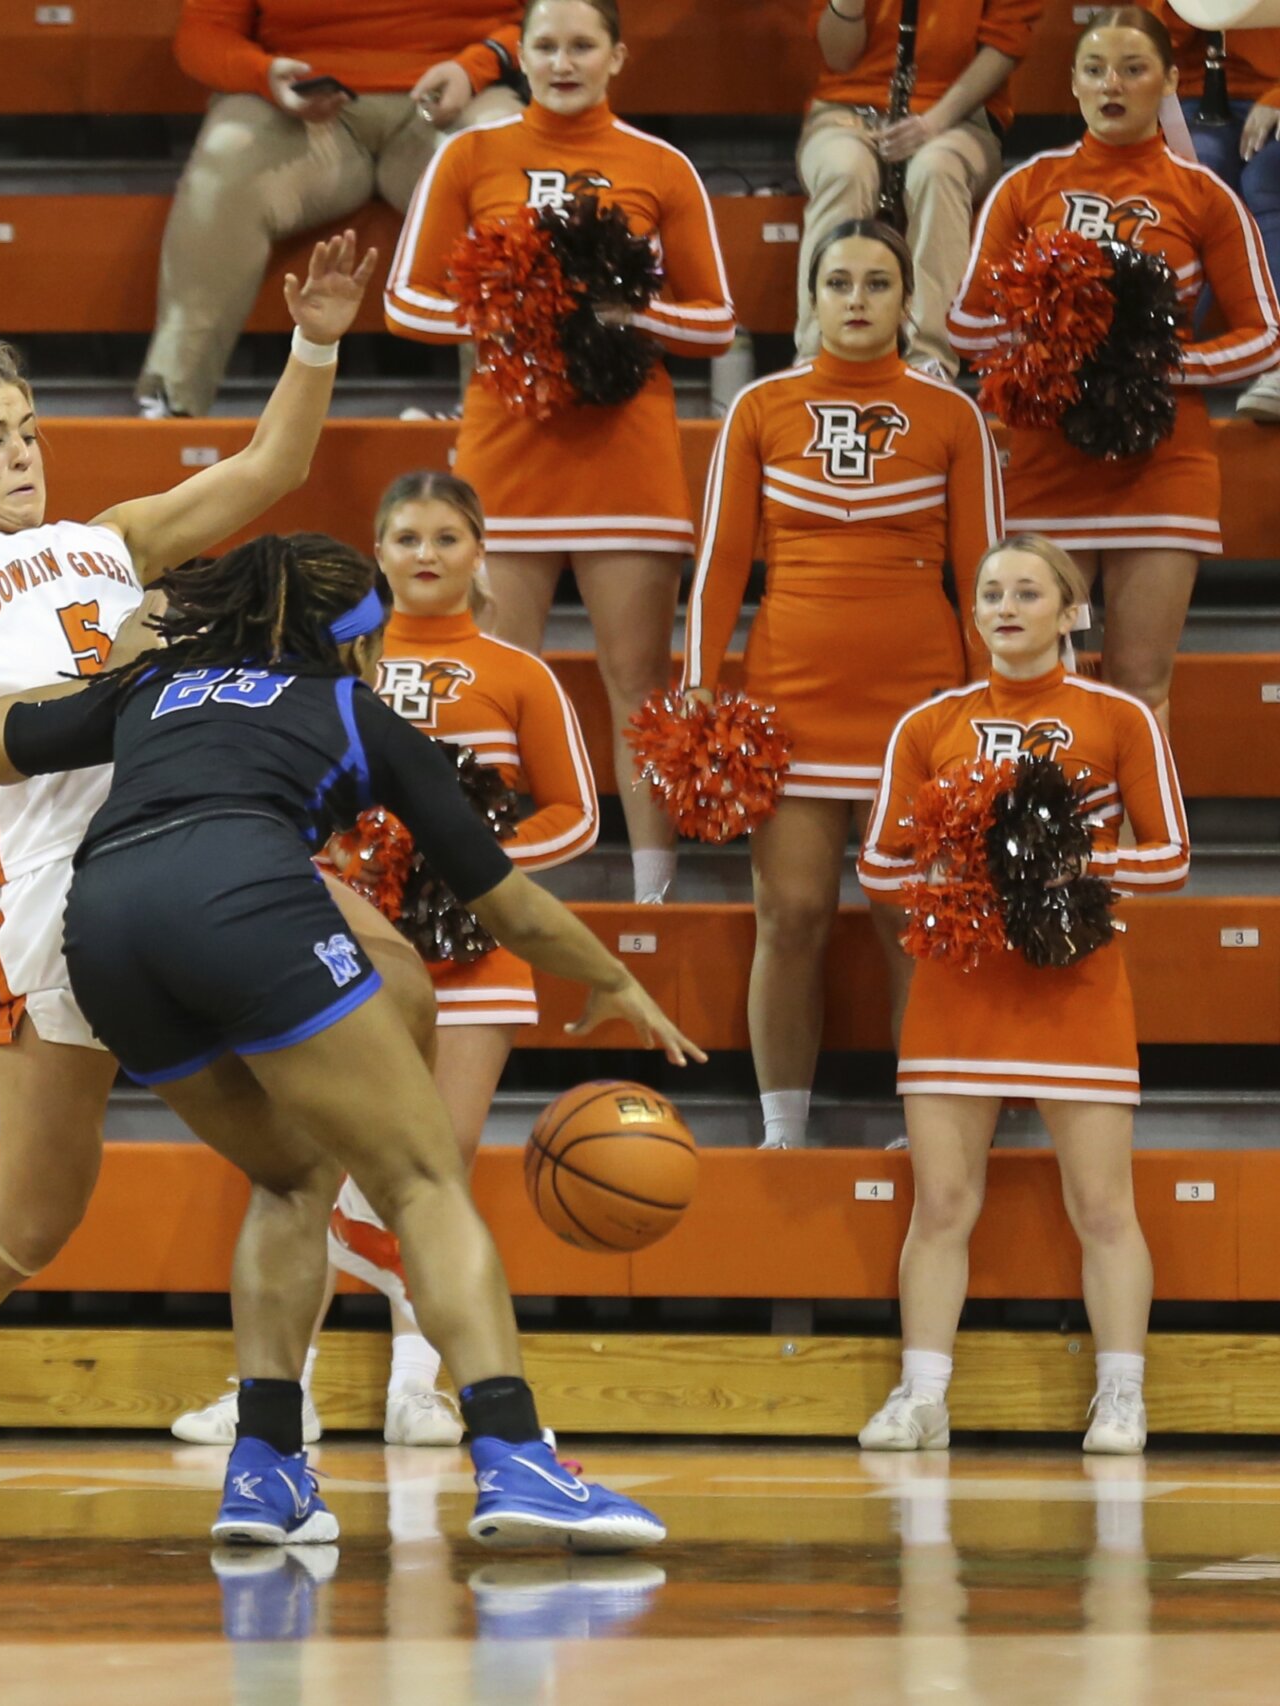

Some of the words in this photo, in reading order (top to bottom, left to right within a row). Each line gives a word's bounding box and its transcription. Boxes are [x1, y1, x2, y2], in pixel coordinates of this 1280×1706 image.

[816, 407, 866, 477] BG
[56, 599, 113, 677] 5
[151, 668, 297, 720] 23
[378, 661, 432, 720] BG
[633, 937, 642, 951] 5
[1235, 931, 1244, 945] 3
[869, 1185, 879, 1199] 4
[1190, 1185, 1200, 1199] 3
